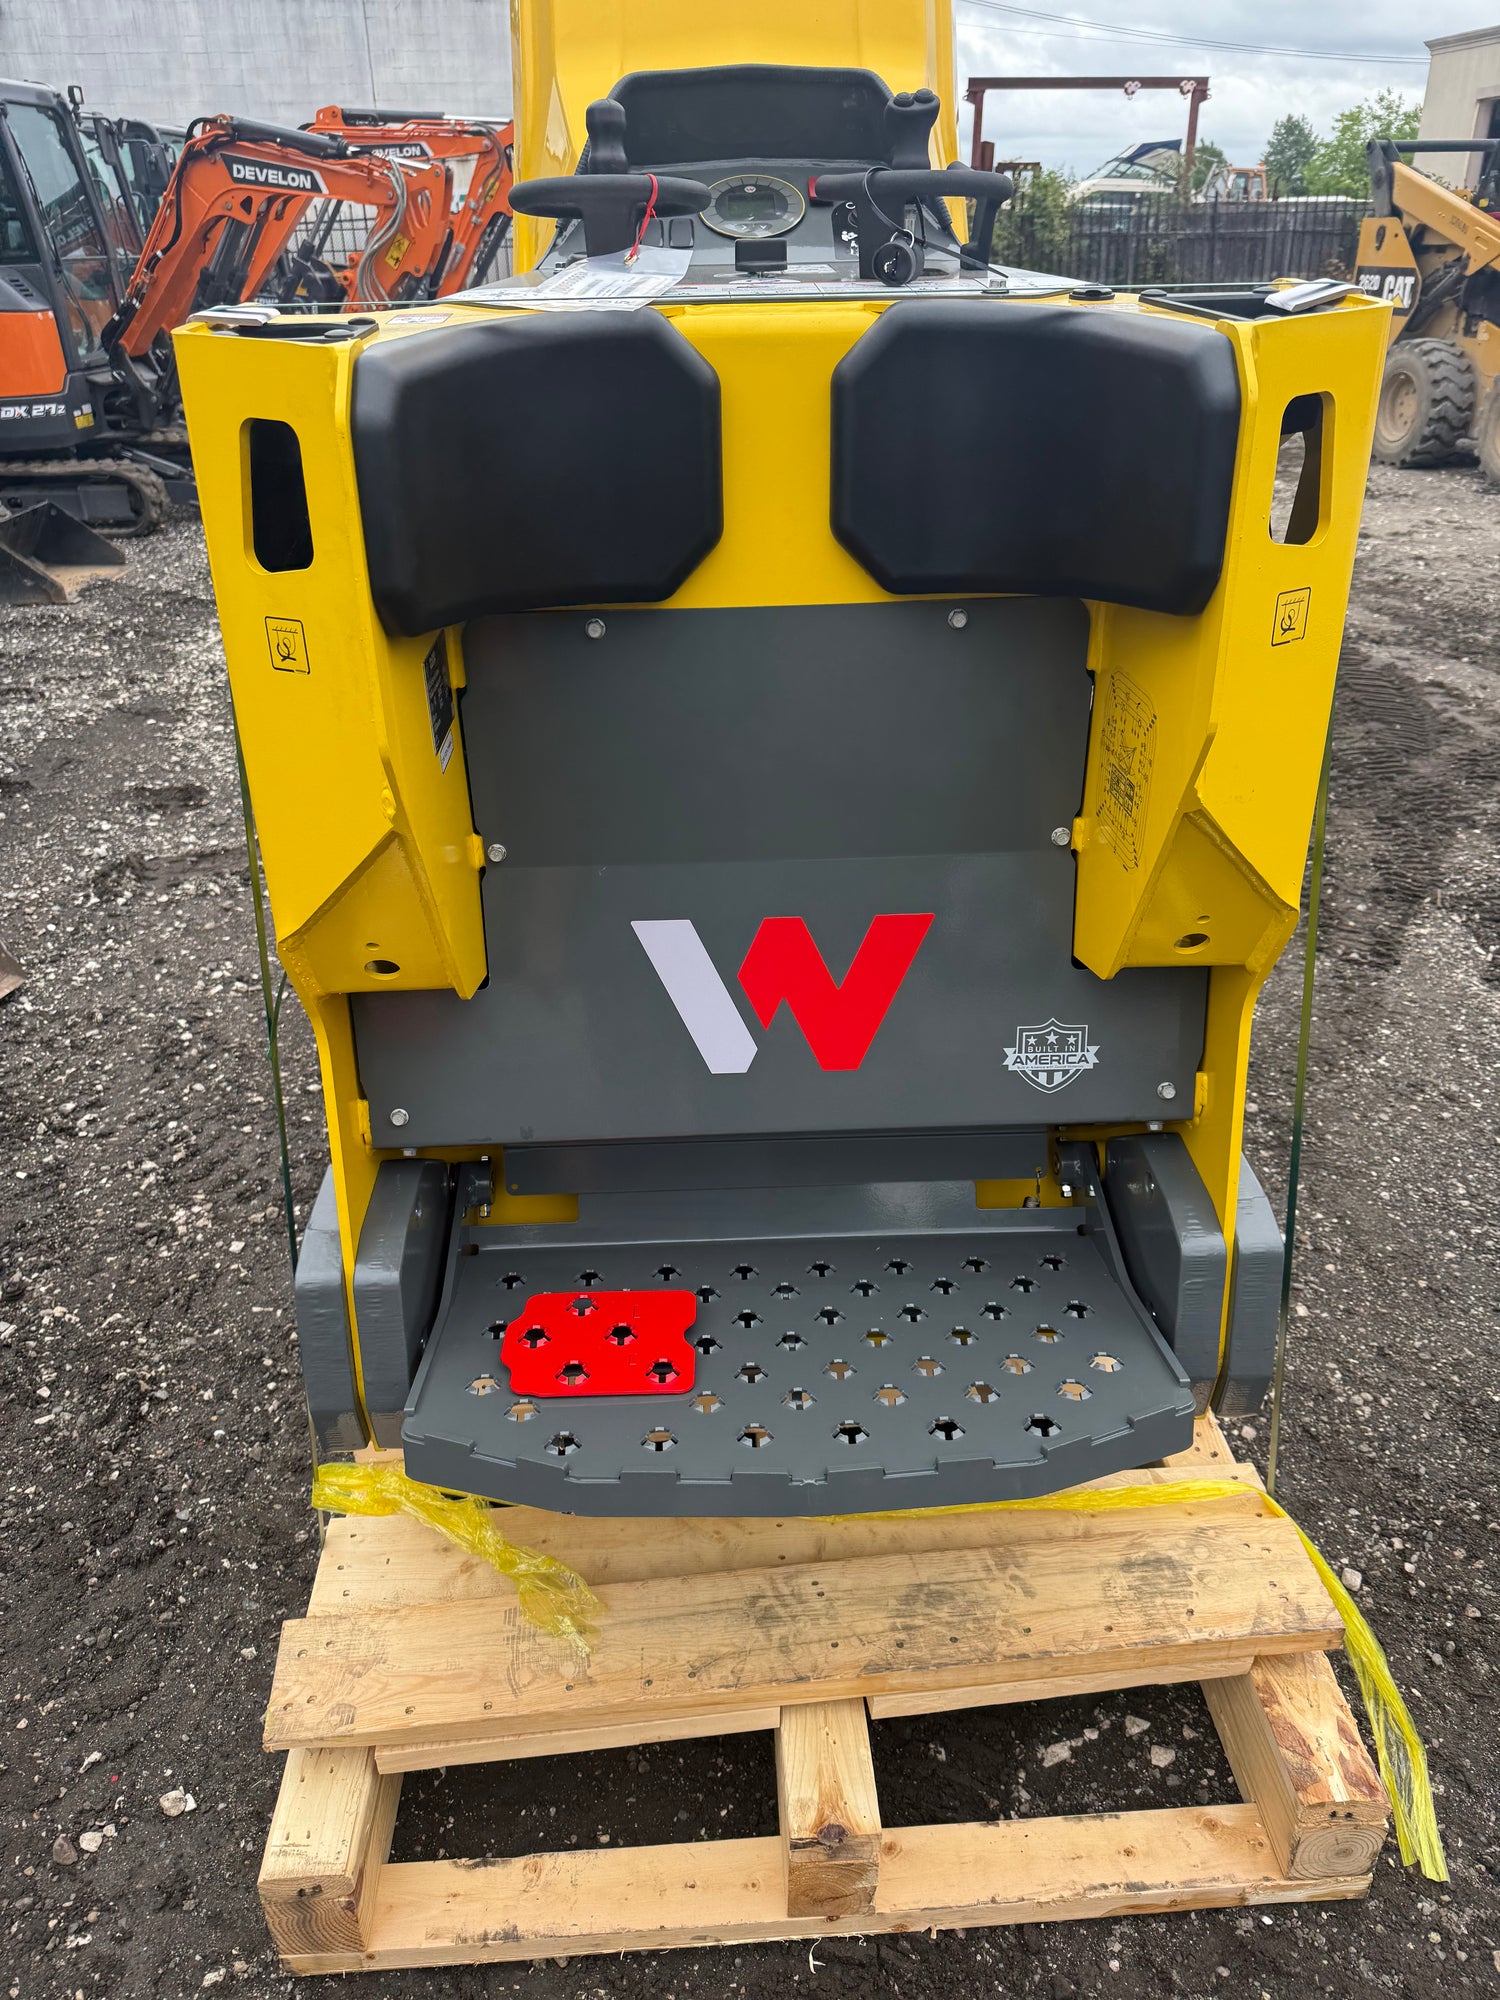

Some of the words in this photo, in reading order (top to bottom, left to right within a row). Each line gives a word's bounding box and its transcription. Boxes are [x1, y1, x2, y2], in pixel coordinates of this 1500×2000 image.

[232, 163, 312, 189] DEVELON
[1382, 275, 1415, 308] CAT
[1027, 1045, 1059, 1053] BUILT
[1012, 1053, 1089, 1066] AMERICA
